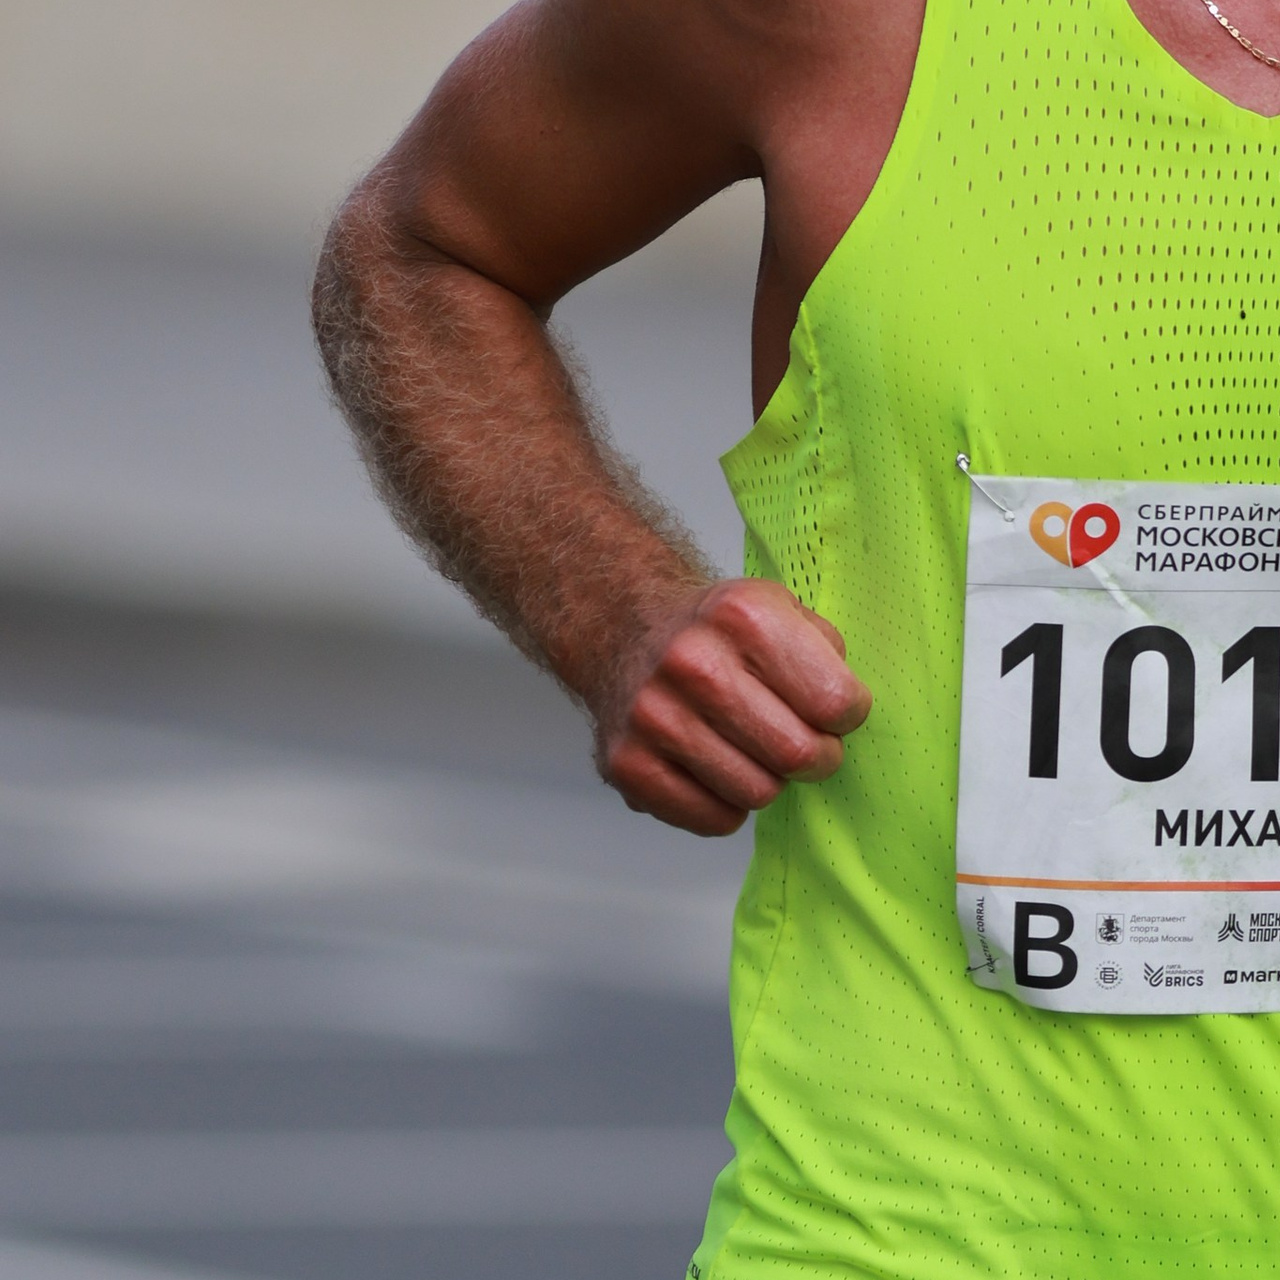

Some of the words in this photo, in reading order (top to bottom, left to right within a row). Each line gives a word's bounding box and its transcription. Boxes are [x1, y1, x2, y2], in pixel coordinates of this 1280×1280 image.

[1135, 552, 1280, 572] МАРАФОН
[976, 896, 985, 933] CORRAL
[1129, 914, 1187, 924] Департамент
[1129, 925, 1159, 934] спорта
[1129, 935, 1159, 944] города
[1161, 934, 1194, 943] Москвы
[1164, 975, 1204, 988] BRICS
